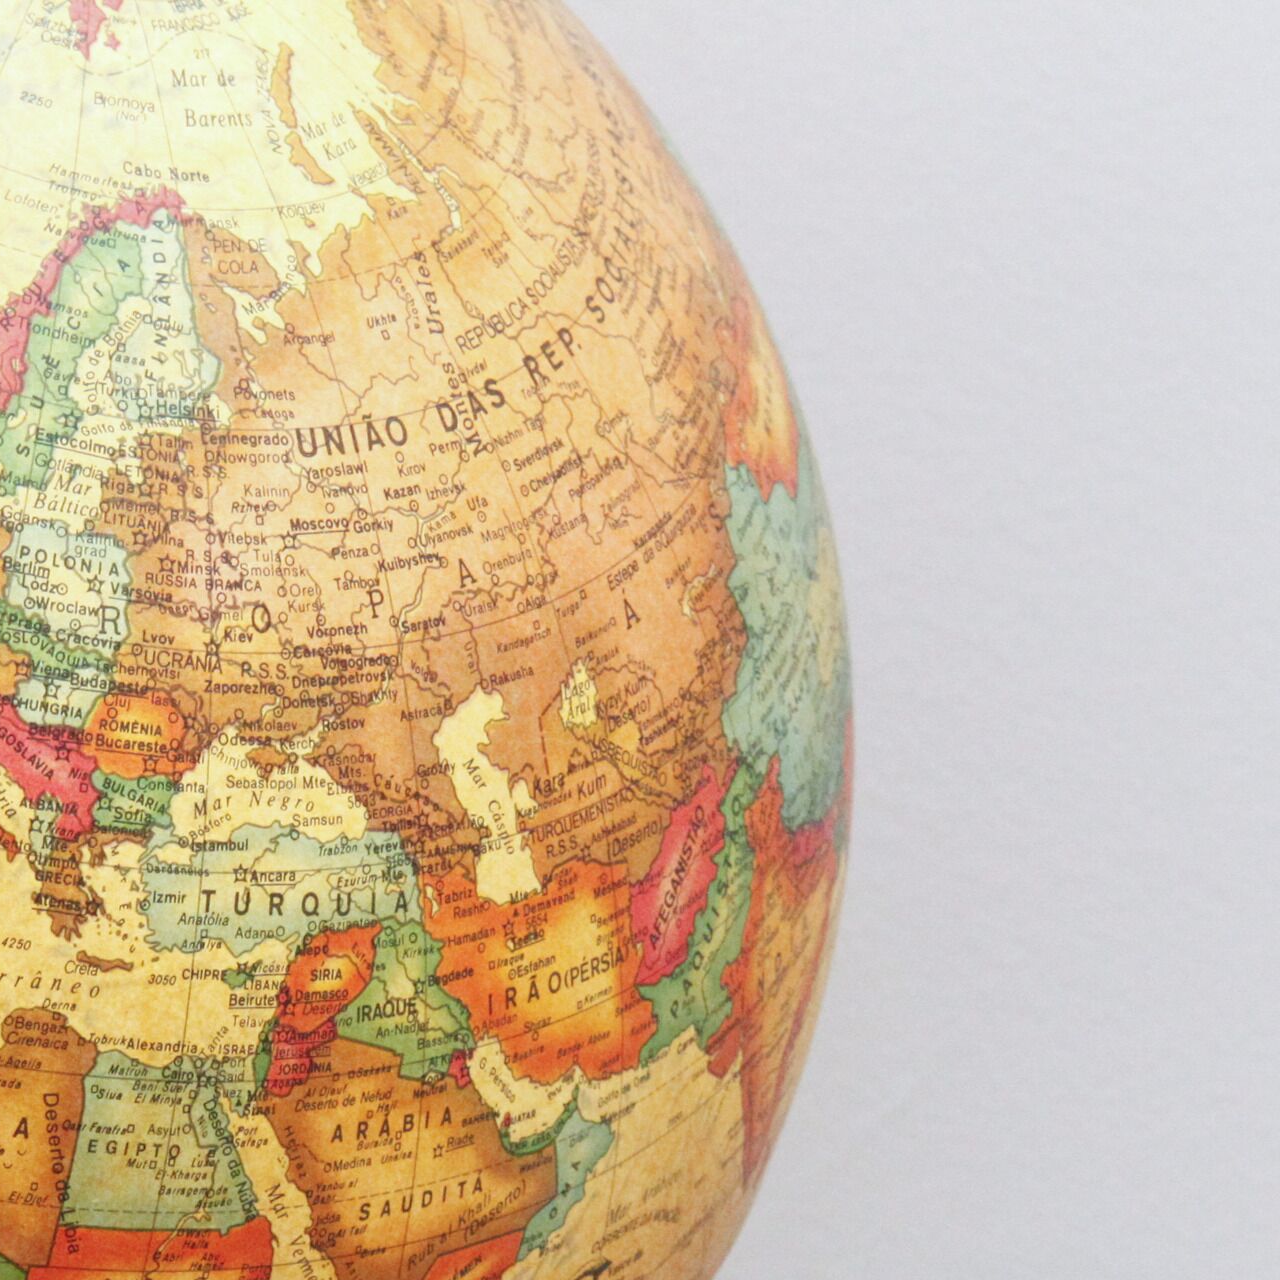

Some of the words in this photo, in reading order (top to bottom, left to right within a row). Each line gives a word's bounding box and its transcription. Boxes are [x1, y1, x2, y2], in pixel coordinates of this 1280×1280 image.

[171, 69, 207, 87] Mar
[214, 70, 237, 88] de
[184, 109, 252, 128] Barents
[122, 161, 162, 181] Cabo
[169, 167, 210, 183] Norte
[297, 417, 409, 458] UNIÃO
[436, 379, 508, 432] DAS
[523, 326, 582, 386] REP.
[35, 426, 116, 456] Estocolmo
[53, 476, 92, 497] Mar
[33, 492, 99, 518] Báltico
[290, 517, 349, 531] Moscovo
[224, 628, 254, 645] Kiev
[18, 696, 83, 720] HUNGRIA
[95, 735, 170, 753] Bucareste
[225, 775, 298, 790] Sebastopol
[193, 795, 232, 819] Mar
[248, 792, 317, 811] Negro
[292, 813, 343, 829] Samsun
[190, 839, 249, 853] Istambul
[250, 869, 296, 883] Ancara
[200, 891, 408, 916] TURQUIA
[182, 967, 226, 982] CHIPRE
[356, 998, 417, 1024] IRAQUE
[126, 1036, 198, 1053] Alexandria
[331, 1107, 454, 1141] ARÁBIA
[87, 1139, 181, 1159] EGIPTO
[358, 1177, 484, 1221] SAUDITA
